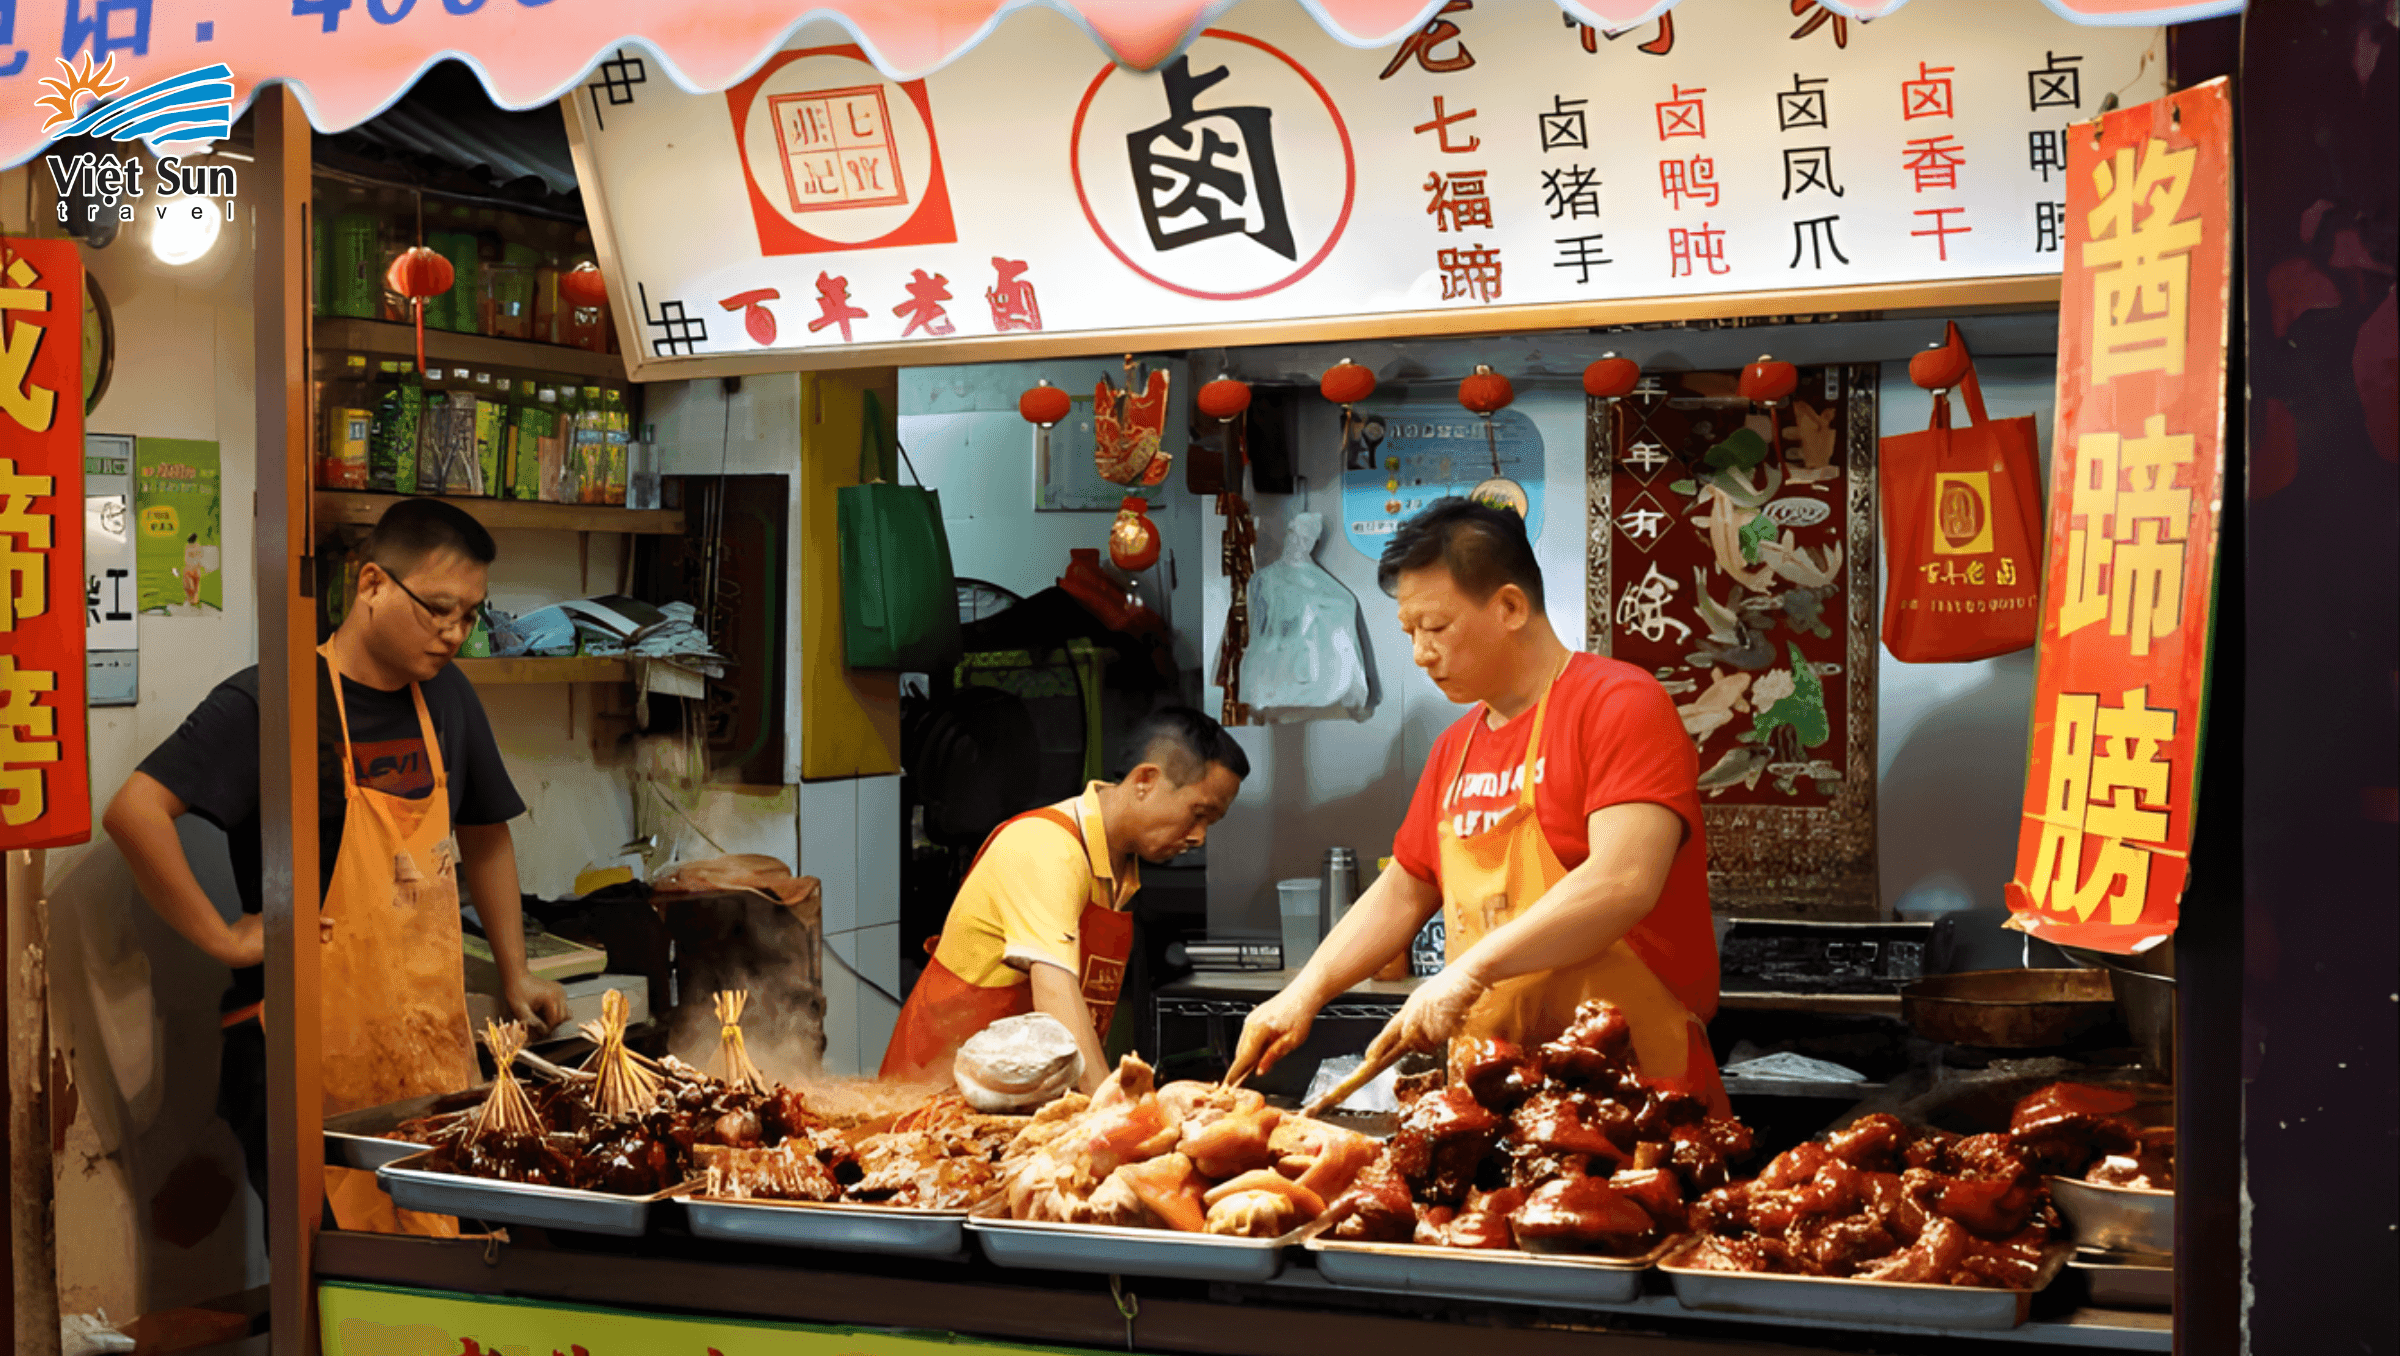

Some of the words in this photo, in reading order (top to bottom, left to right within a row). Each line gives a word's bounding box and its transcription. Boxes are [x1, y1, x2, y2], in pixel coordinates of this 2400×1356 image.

[1414, 95, 1502, 303] 七福蹄
[1539, 94, 1613, 284] 卤猪手
[1655, 83, 1731, 278] 卤鸭肫
[1777, 72, 1850, 270] 卤凤爪
[1902, 61, 1972, 262] 卤香干
[2030, 138, 2203, 926] 酱蹄膀
